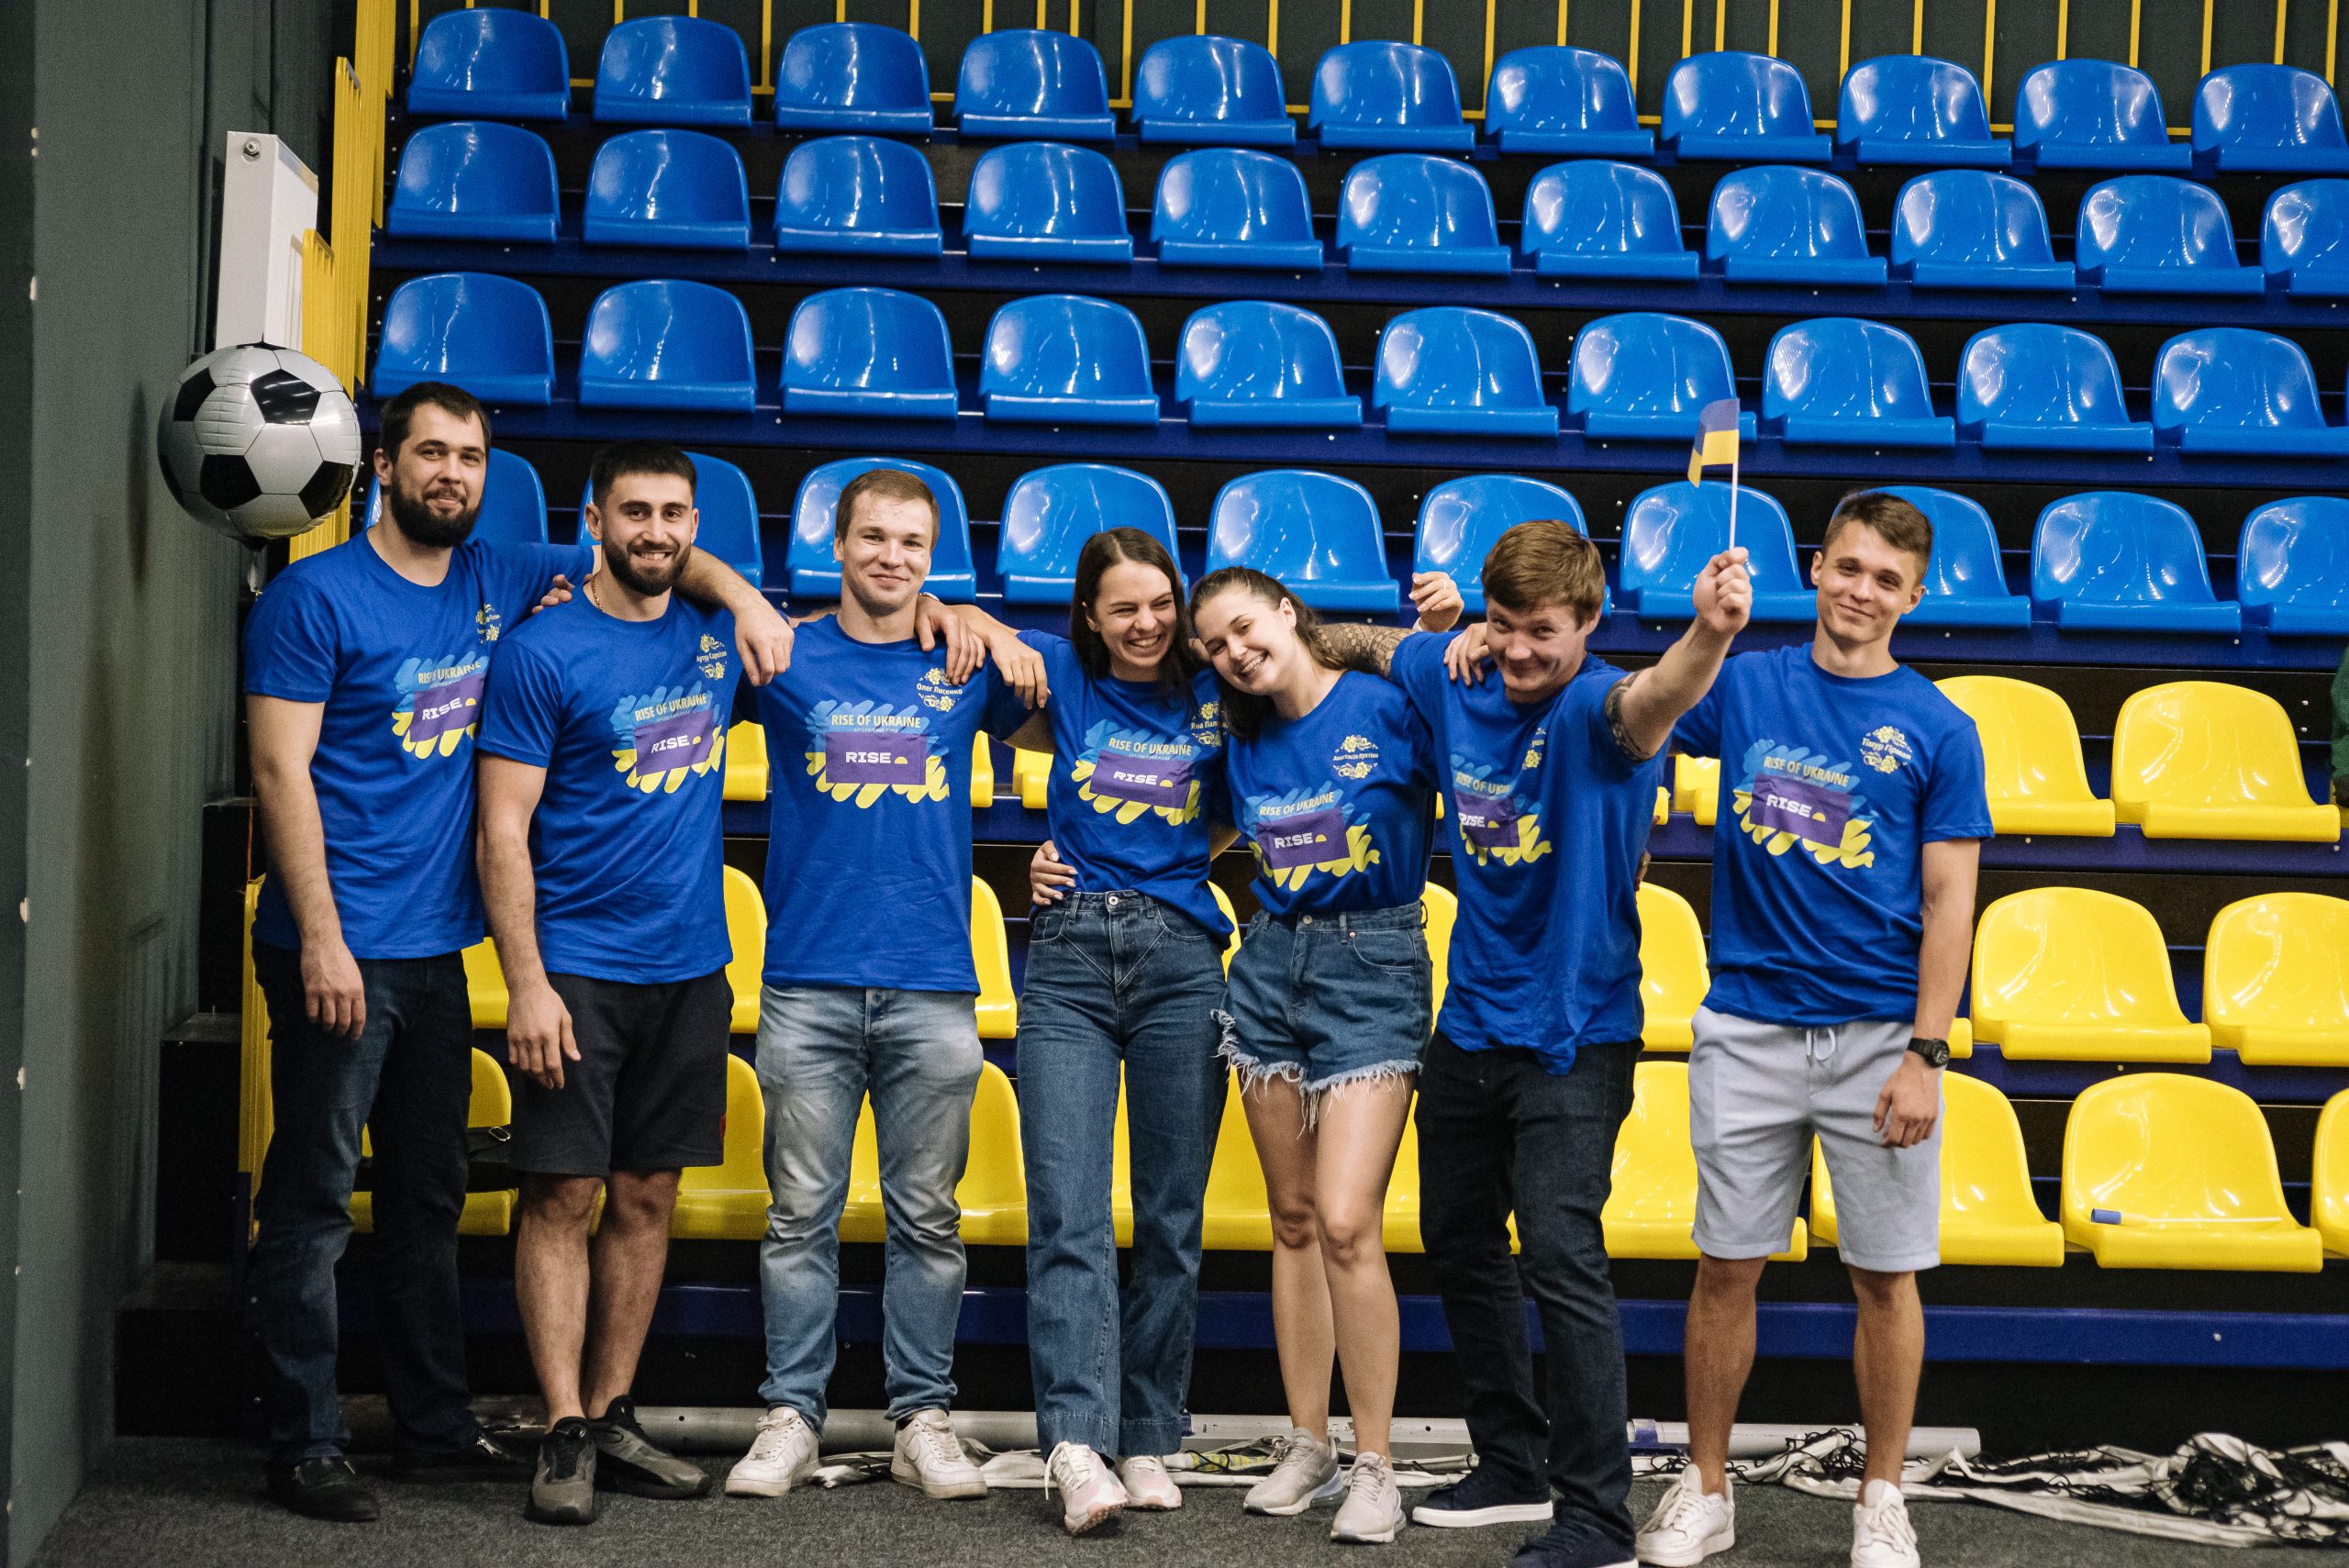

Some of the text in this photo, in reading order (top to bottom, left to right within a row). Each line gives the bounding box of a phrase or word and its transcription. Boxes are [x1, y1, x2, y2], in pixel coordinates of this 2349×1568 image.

[917, 683, 963, 695] Олег Лисенко
[422, 697, 463, 720] RISE
[635, 706, 655, 722] RISE
[656, 702, 667, 716] OF
[669, 693, 707, 712] UKRAINE
[831, 714, 921, 728] RISE OF UKRAINE
[651, 735, 690, 754] RISE
[1108, 737, 1132, 751] RISE
[1133, 741, 1148, 753] OF
[1148, 744, 1193, 757] UKRAINE
[845, 751, 892, 764] RISE
[1113, 771, 1158, 785] RISE
[1764, 756, 1785, 771] RISE
[1787, 761, 1802, 773] OF
[1802, 764, 1850, 787] UKRAINE
[1473, 779, 1486, 792] OF
[1259, 805, 1281, 817] RISE
[1283, 801, 1296, 814] OF
[1297, 792, 1334, 811] UKRAINE
[1765, 794, 1812, 818] RISE
[1274, 832, 1313, 850] RISE
